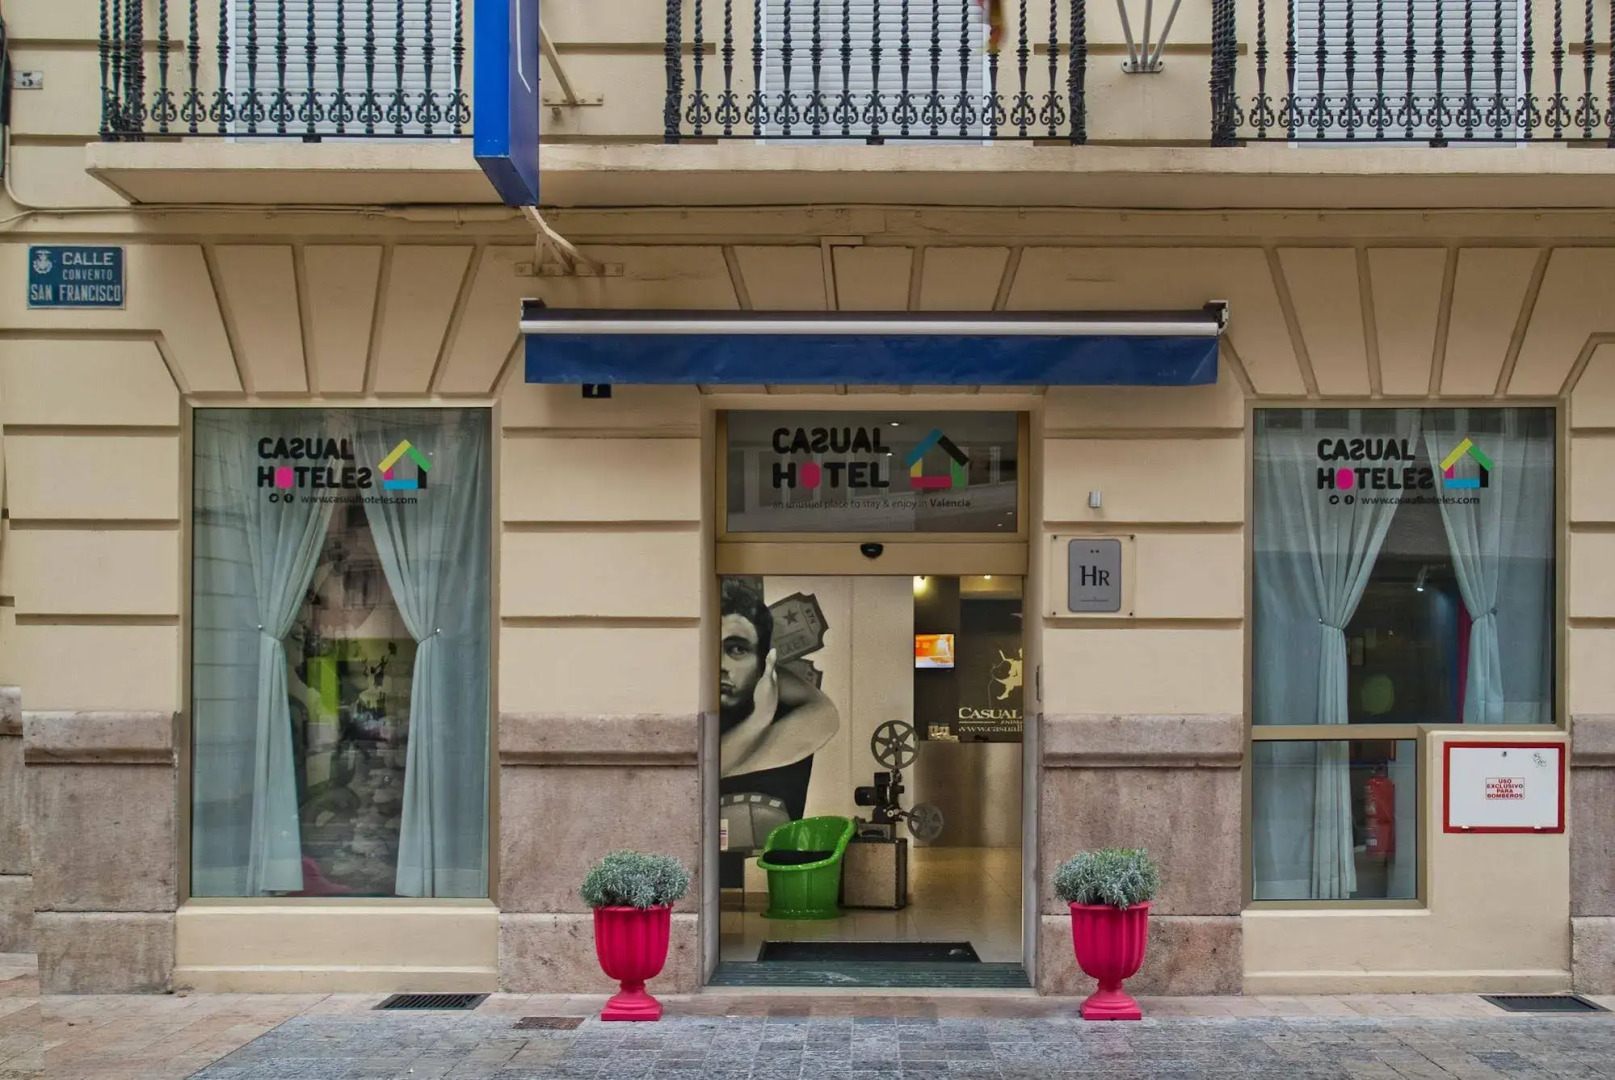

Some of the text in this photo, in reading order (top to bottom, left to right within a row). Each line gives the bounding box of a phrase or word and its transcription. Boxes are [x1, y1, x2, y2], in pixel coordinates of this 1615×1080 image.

[62, 252, 114, 266] CALLE
[62, 269, 113, 280] CONVENTO
[31, 284, 121, 302] SAN FRANCISCO
[258, 437, 355, 460] CASUAL
[772, 427, 890, 454] CASUAL
[1317, 438, 1416, 461] CASUAL
[257, 466, 372, 489] HOTELES
[772, 461, 890, 489] HOTEL
[1317, 467, 1434, 490] HOTELES
[300, 494, 418, 504] www.casualhoteles.com
[786, 499, 822, 509] unusual
[824, 498, 849, 511] place
[850, 499, 861, 509] to
[863, 499, 880, 510] stay
[892, 499, 917, 510] enjoy
[930, 498, 971, 508] Valencia
[1361, 495, 1480, 505] www.casualhoteles.com
[958, 707, 1023, 719] CASUAL
